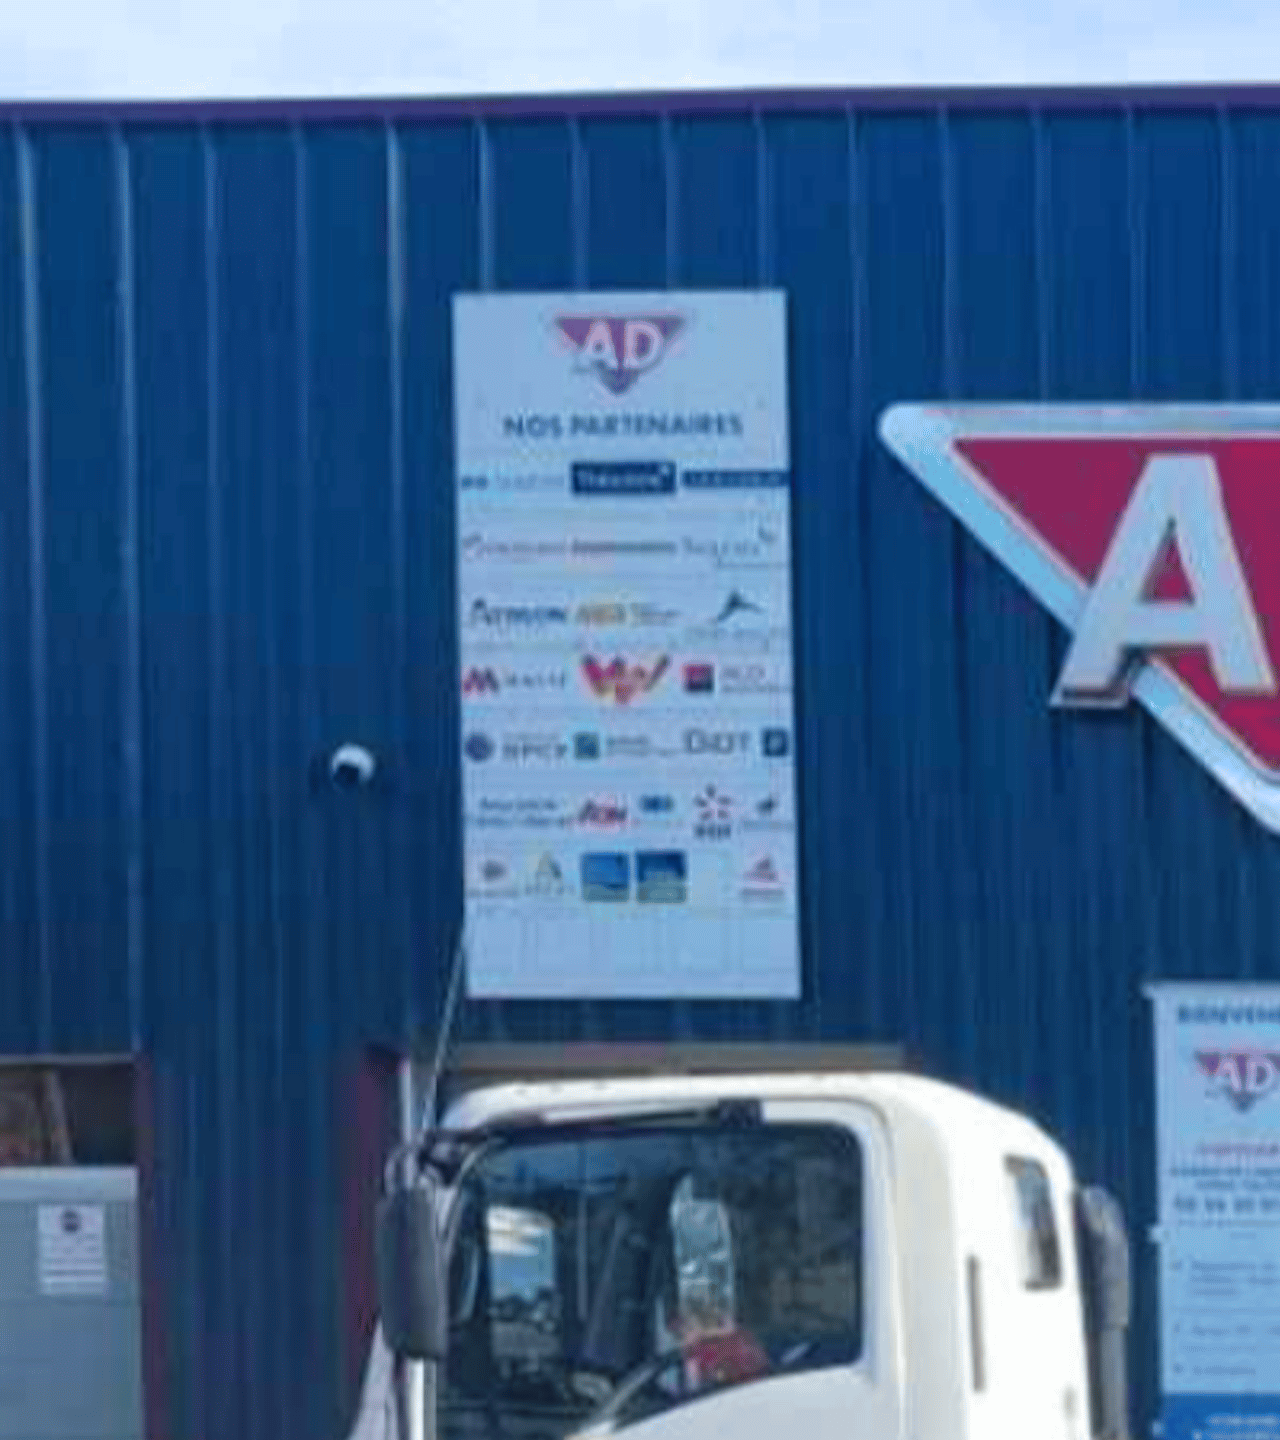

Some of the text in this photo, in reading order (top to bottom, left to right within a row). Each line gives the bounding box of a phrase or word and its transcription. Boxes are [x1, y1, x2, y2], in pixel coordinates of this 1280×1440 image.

[575, 319, 665, 371] AD
[503, 412, 744, 438] NOS PARTENAIRES
[1208, 1060, 1275, 1095] AD
